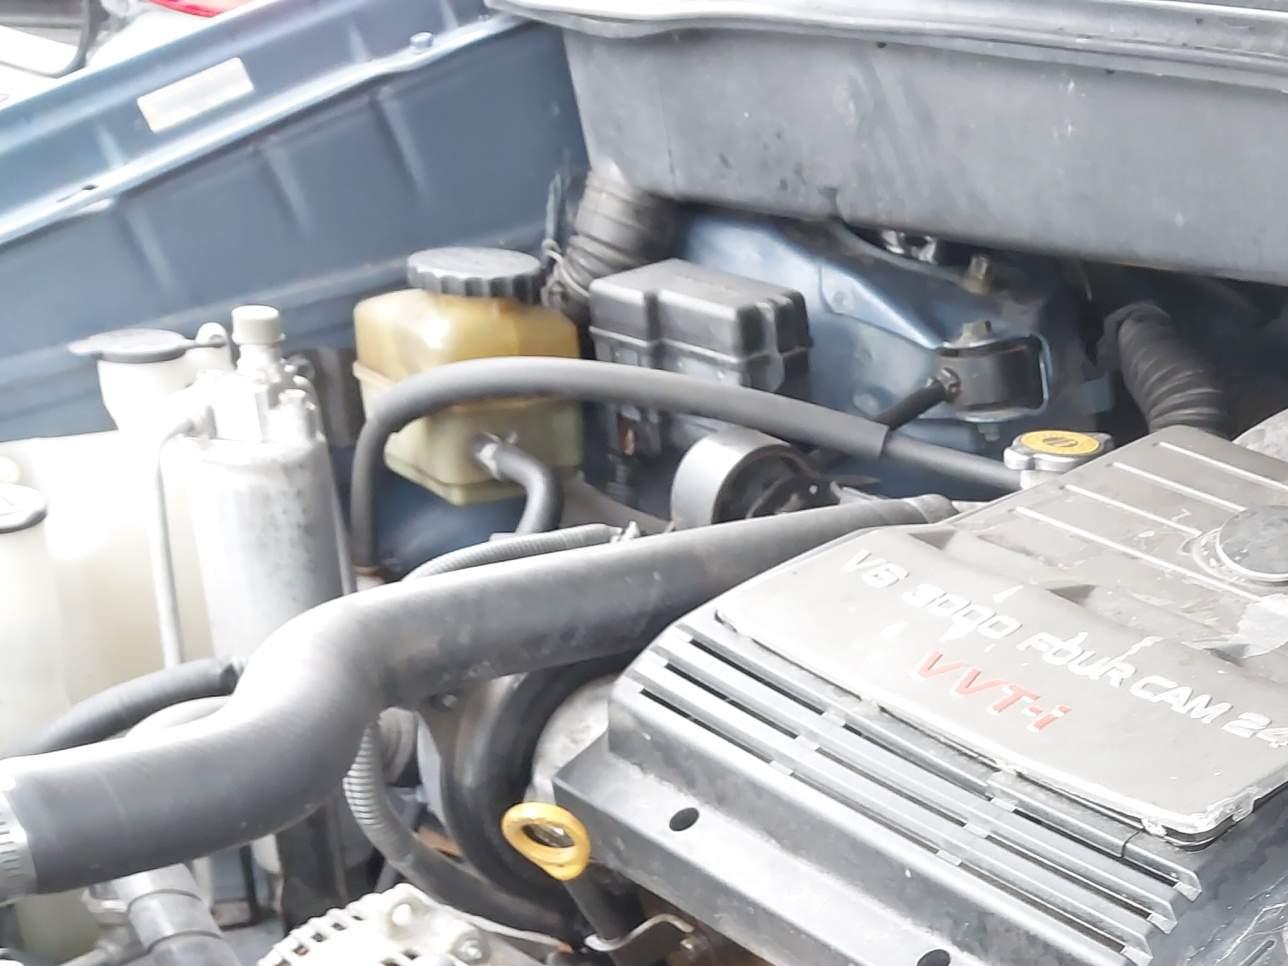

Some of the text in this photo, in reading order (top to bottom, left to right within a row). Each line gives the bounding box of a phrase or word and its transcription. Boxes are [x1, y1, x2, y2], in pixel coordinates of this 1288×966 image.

[843, 549, 910, 588] V6
[901, 582, 1023, 640] 3000
[1016, 631, 1138, 688] FOUR
[1130, 675, 1234, 724] CAM
[914, 650, 1072, 731] VVT-i
